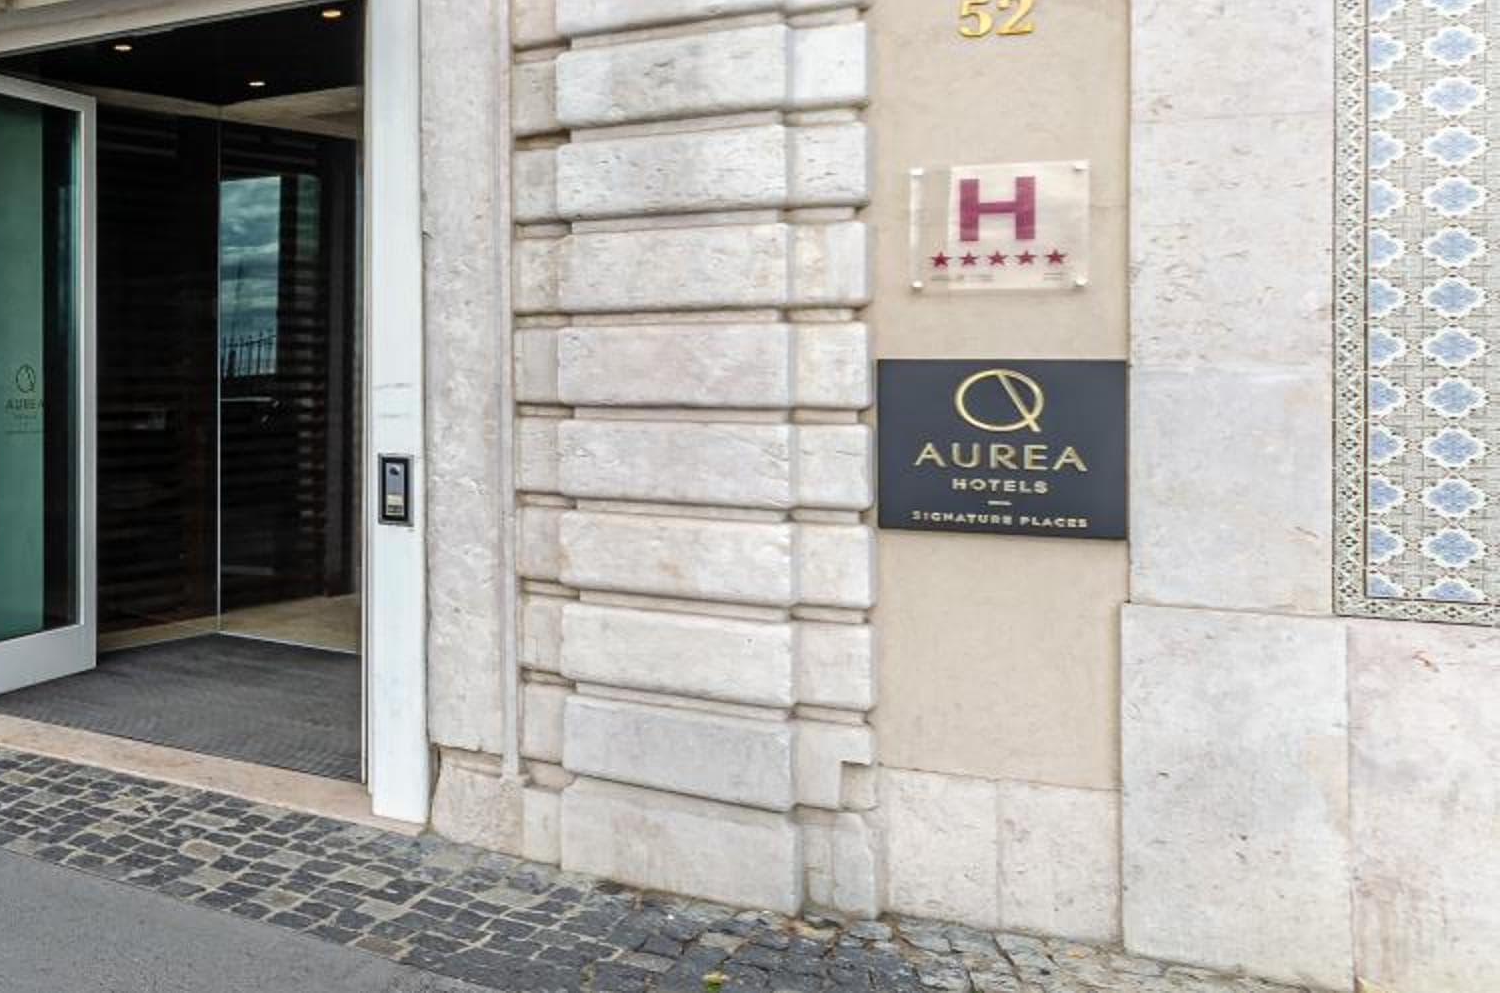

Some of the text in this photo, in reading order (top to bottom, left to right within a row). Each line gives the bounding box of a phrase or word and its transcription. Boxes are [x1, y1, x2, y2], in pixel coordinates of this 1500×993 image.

[959, 176, 1036, 242] H
[913, 442, 1088, 472] AUREA
[951, 478, 1049, 494] HOTELS
[912, 510, 1088, 528] SIGNATURE PLACES
